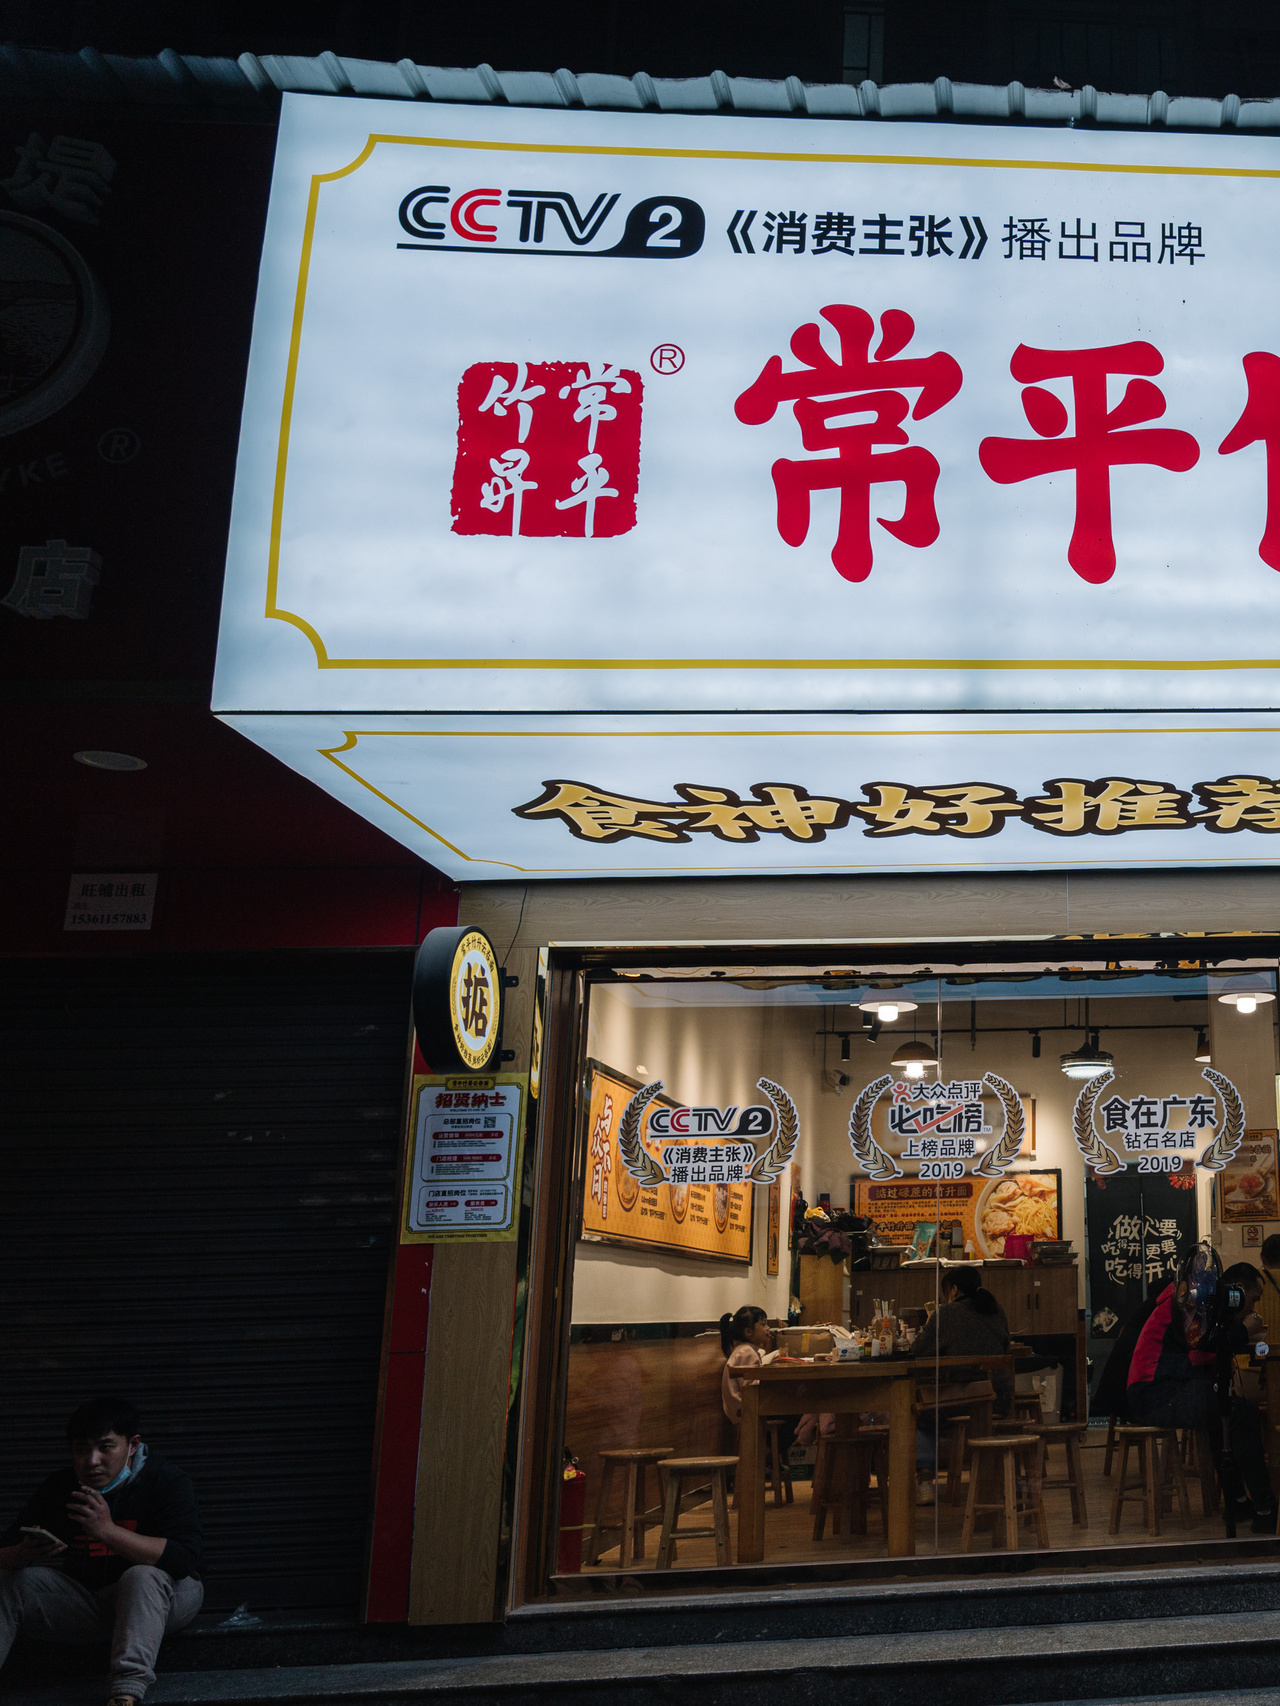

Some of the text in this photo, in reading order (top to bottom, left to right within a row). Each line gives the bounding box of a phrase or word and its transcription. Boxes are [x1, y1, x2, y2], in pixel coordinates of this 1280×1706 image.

[2, 540, 100, 619] 店
[81, 883, 146, 898] 旺铺出租
[71, 913, 147, 924] 15361157883
[435, 1092, 507, 1108] 招贤纳士
[913, 1082, 982, 1100] 大众点评
[650, 1107, 739, 1133] CCTV
[890, 1103, 982, 1133] 必吃榜
[1102, 1096, 1216, 1131] 食在广东
[903, 1138, 975, 1157] 上榜品牌
[1124, 1131, 1195, 1149] 钻石名店
[663, 1146, 756, 1164] 《消费主张》
[1140, 1156, 1181, 1171] 2019
[671, 1165, 744, 1183] 播出品牌
[920, 1163, 964, 1178] 2019
